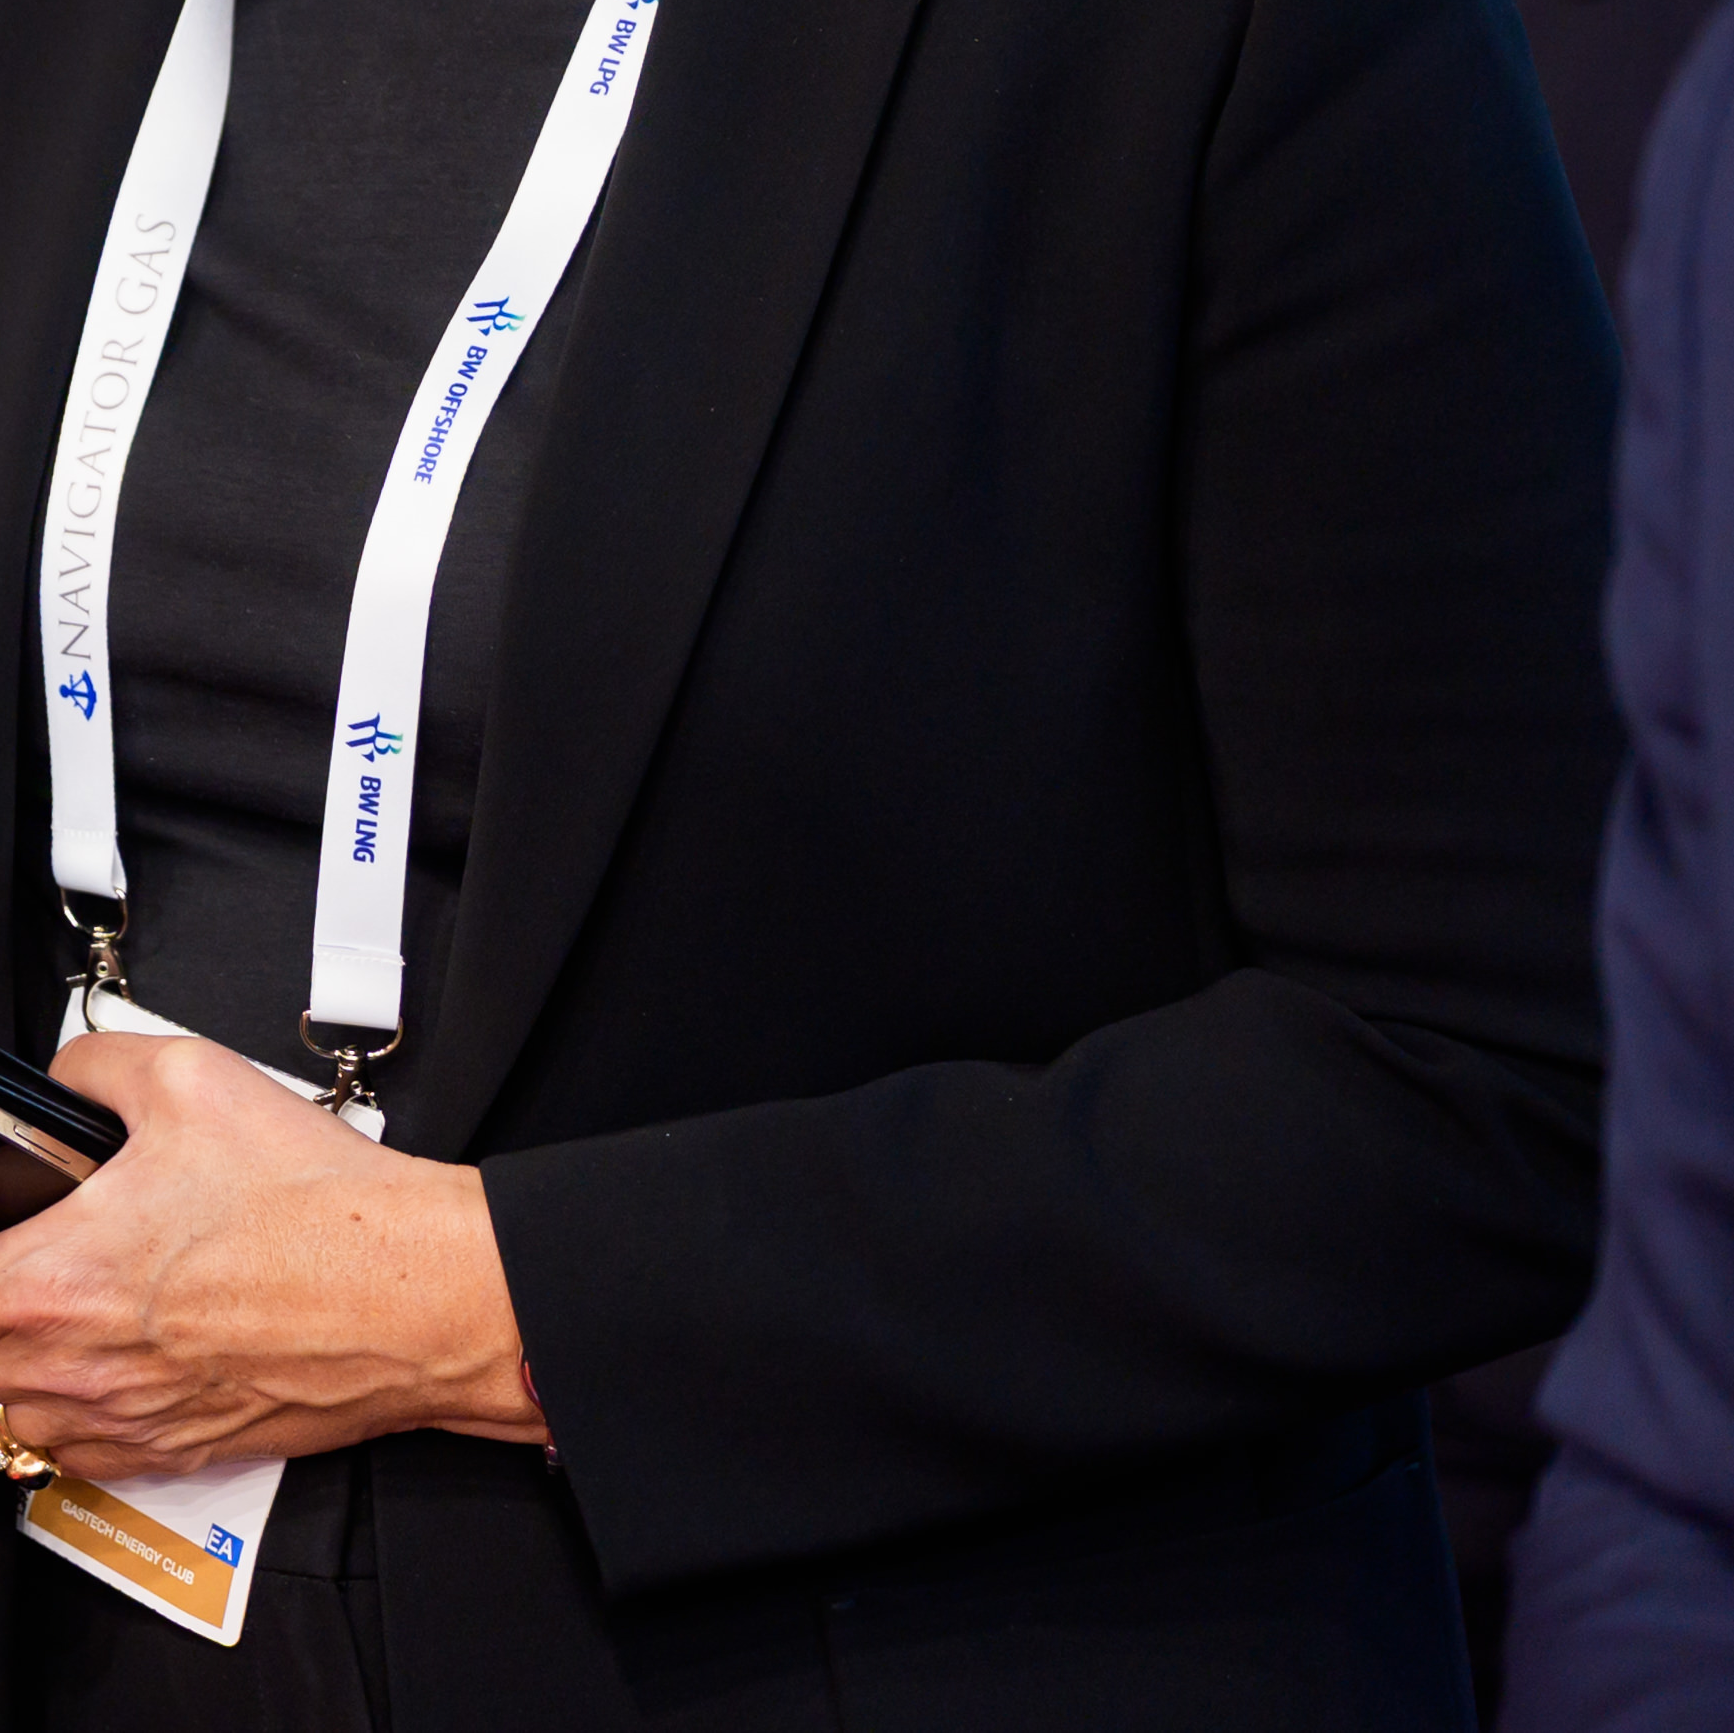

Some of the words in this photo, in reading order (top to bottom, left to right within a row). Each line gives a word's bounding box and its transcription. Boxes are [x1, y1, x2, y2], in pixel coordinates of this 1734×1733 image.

[607, 18, 637, 55] BW
[589, 57, 621, 96] LPG
[457, 345, 488, 381] BW
[58, 336, 146, 660] NAVIGATOR
[115, 213, 177, 315] GAS
[413, 382, 469, 485] OFFSHORE
[357, 775, 382, 816] BW
[352, 818, 378, 864] LNG
[60, 1498, 115, 1539] GASTECH
[115, 1529, 163, 1566] ENERGY
[162, 1557, 195, 1586] CLUB
[205, 1528, 233, 1561] EA
